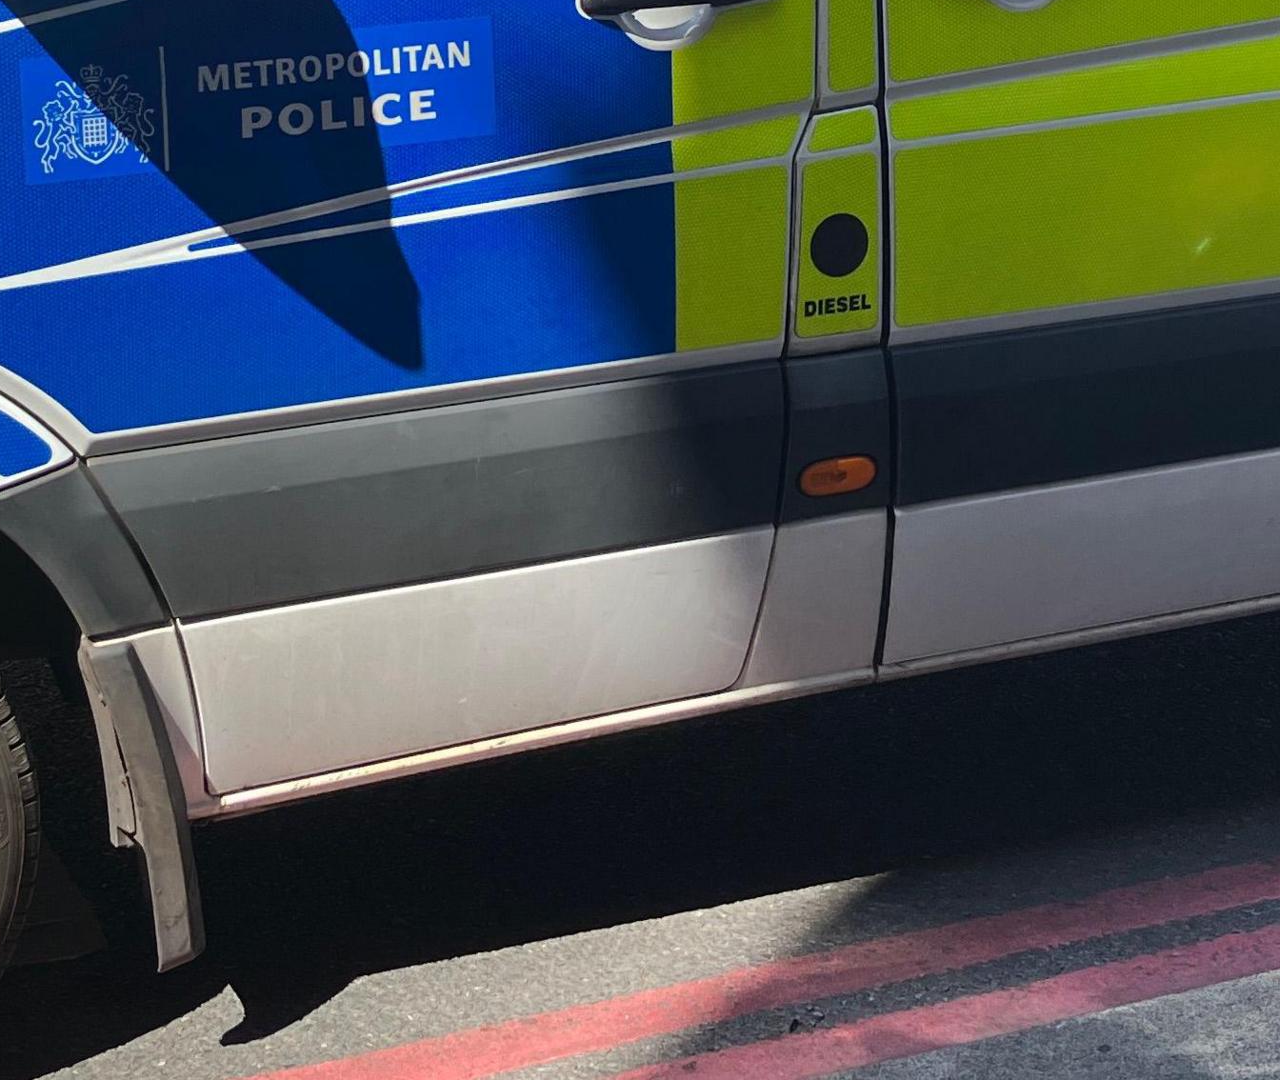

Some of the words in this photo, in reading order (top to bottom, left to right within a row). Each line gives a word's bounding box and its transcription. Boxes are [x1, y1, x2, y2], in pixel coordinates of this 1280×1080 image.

[197, 40, 471, 93] METROPOLITAN
[241, 88, 437, 139] POLICE
[804, 293, 872, 318] DIESEL
